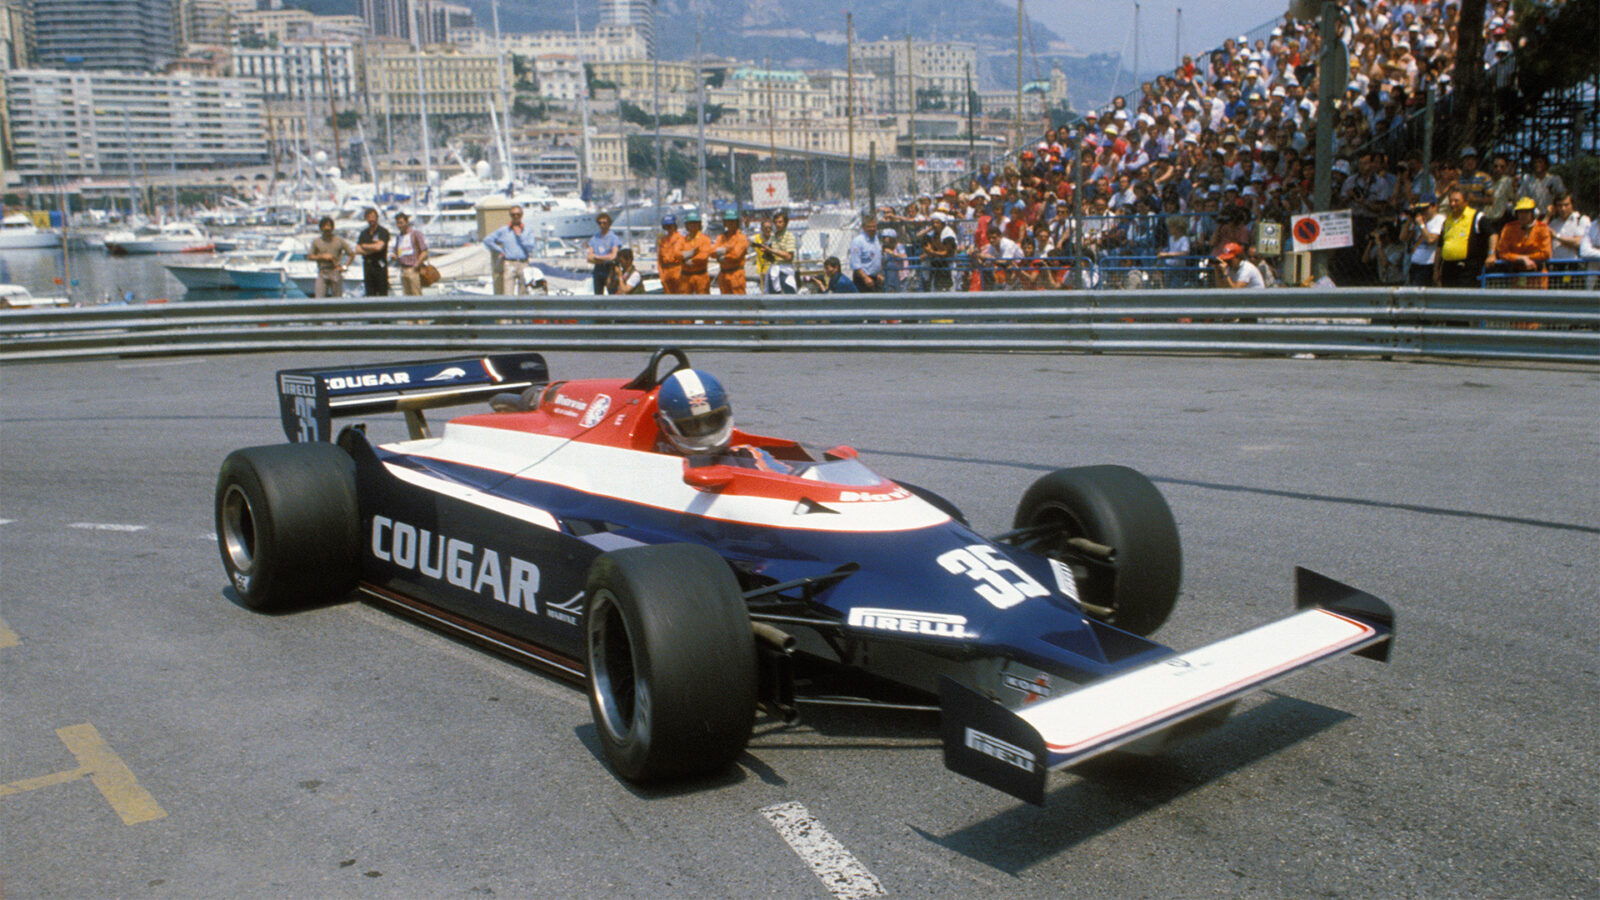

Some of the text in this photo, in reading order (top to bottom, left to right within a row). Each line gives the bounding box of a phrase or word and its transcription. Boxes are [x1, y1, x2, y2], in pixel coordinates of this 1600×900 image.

[280, 374, 316, 396] PIRELLI
[295, 396, 319, 443] 35
[372, 515, 540, 615] COUGAR
[936, 544, 1051, 609] 35
[848, 607, 968, 638] PIRELLI
[965, 726, 1036, 773] PIRELLI
